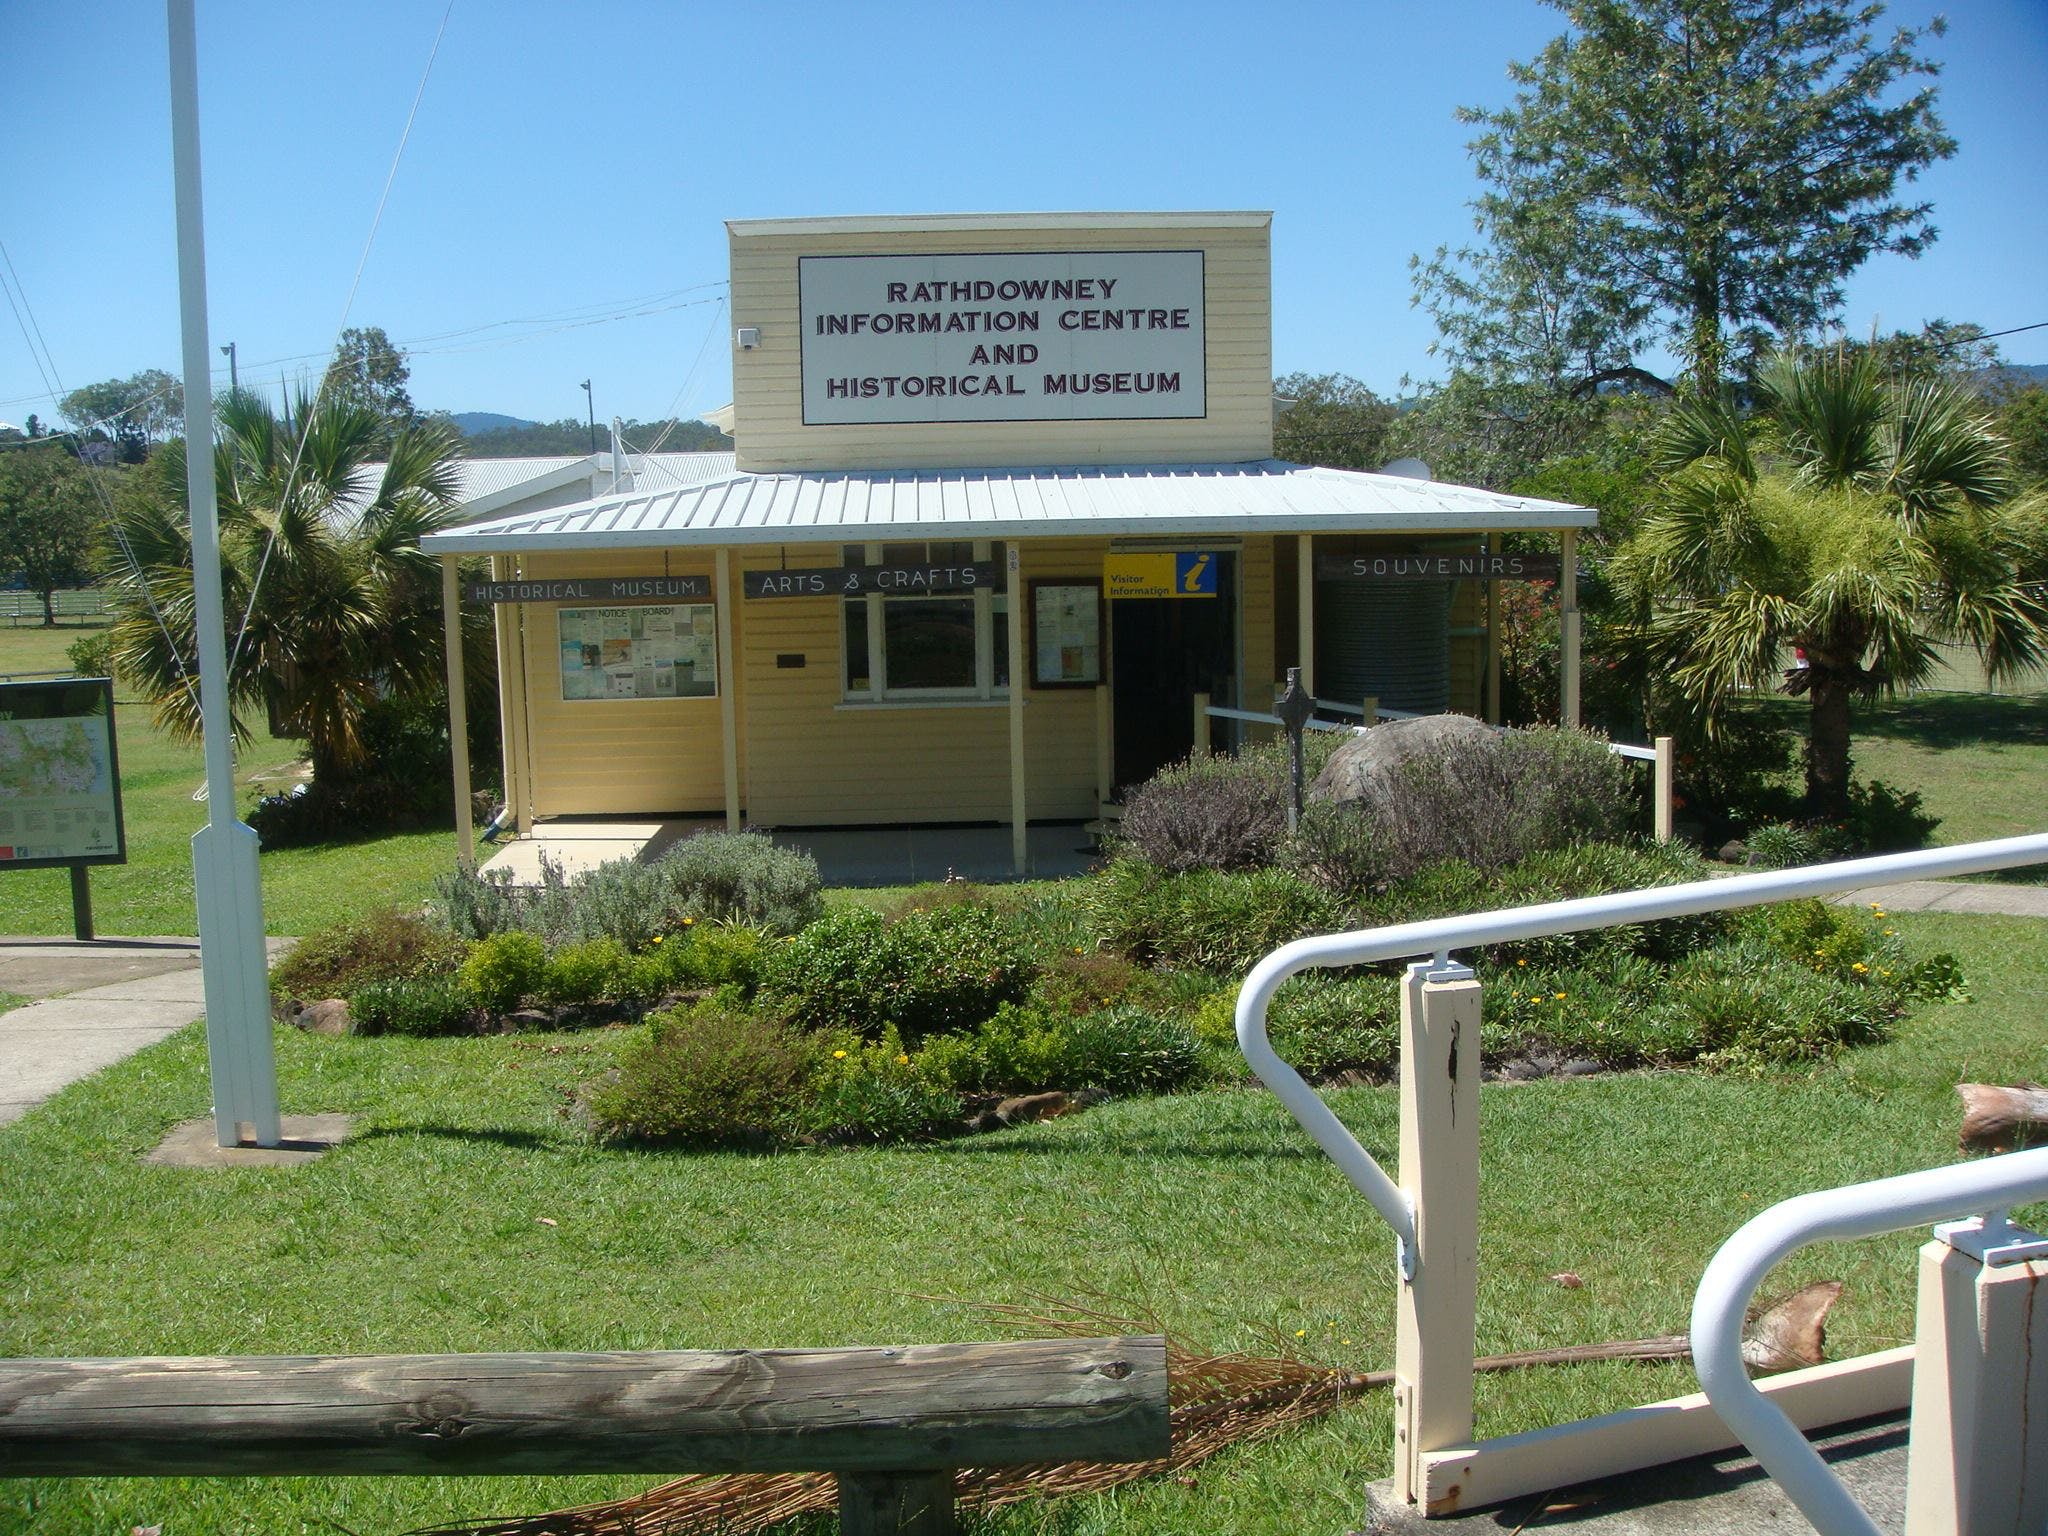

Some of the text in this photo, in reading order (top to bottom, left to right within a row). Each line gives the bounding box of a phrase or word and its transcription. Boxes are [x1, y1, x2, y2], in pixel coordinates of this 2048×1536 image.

[887, 278, 1118, 303] RATHDOWNEY
[816, 308, 1190, 336] INFORMATION CENTRE
[969, 343, 1039, 366] AND
[826, 372, 1181, 399] HISTORICAL MUSEUM
[1353, 558, 1524, 577] SOUVENIRS
[761, 567, 977, 594] ARTS & CRAFTS
[1110, 575, 1145, 584] Visitor
[475, 583, 590, 600] HISTORICAL
[1110, 586, 1170, 596] Information
[598, 608, 628, 618] NOTICE
